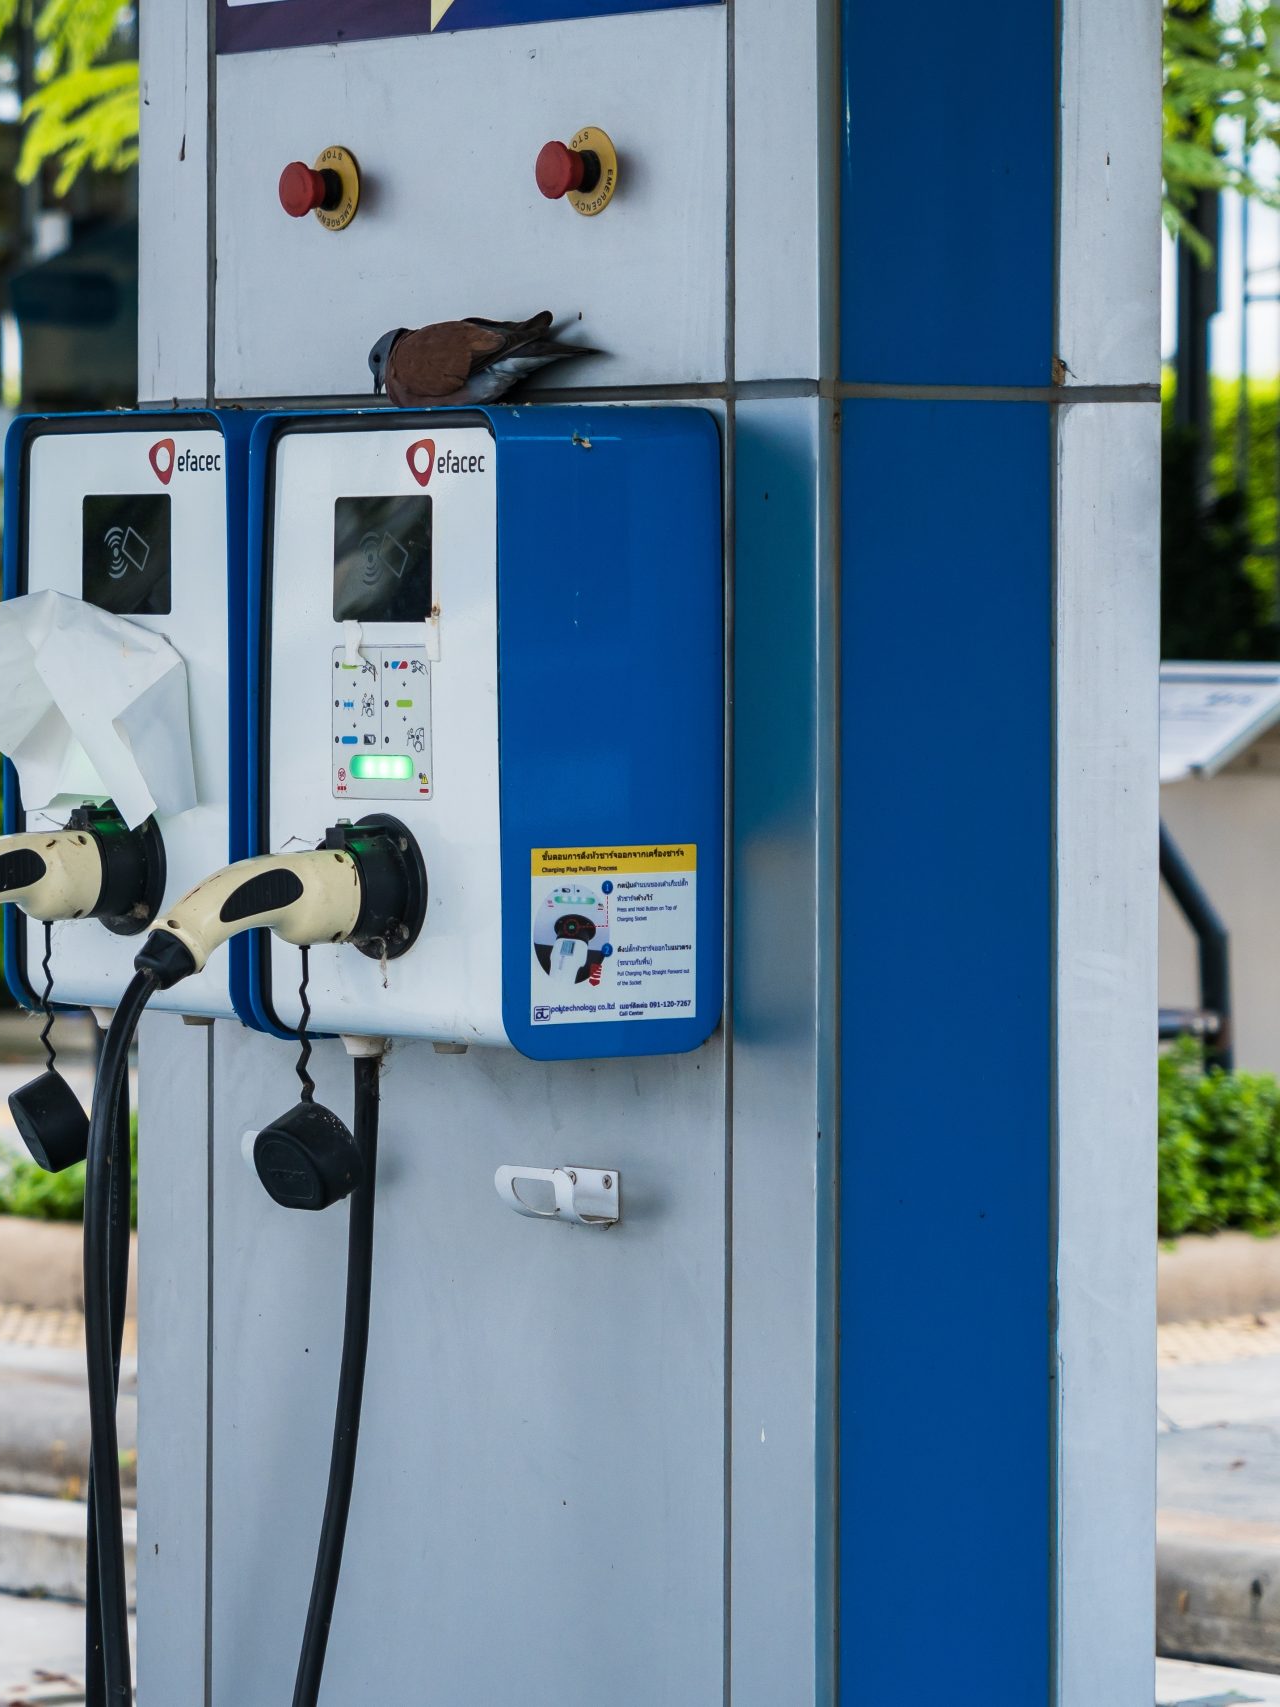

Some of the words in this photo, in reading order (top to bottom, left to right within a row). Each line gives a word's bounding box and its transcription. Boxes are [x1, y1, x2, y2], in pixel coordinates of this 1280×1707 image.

[570, 131, 589, 149] STO
[322, 150, 343, 162] STOP
[574, 169, 614, 212] EMERGENCY
[316, 203, 353, 228] EMERGENC
[177, 448, 221, 473] efacec
[437, 449, 485, 474] efacec
[550, 1003, 596, 1015] polytechnology
[649, 1000, 692, 1008] 091-120-7267
